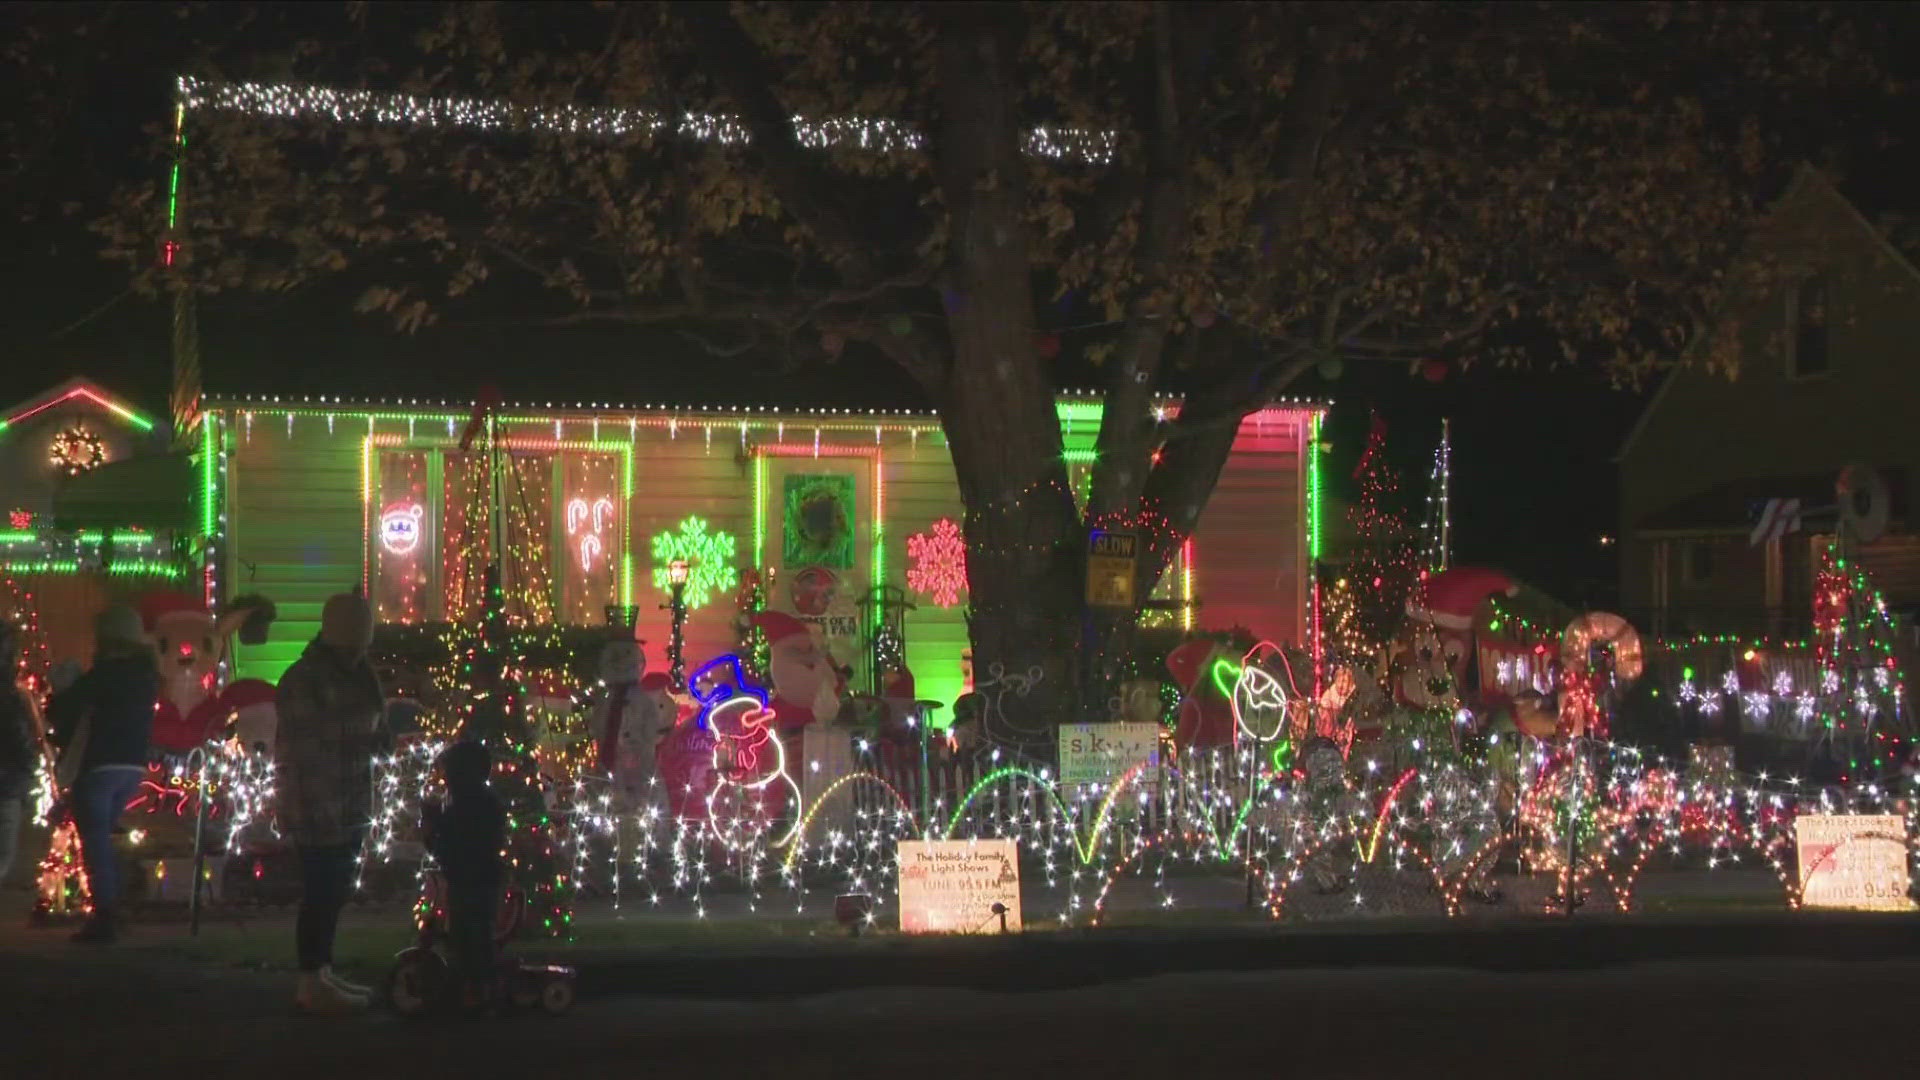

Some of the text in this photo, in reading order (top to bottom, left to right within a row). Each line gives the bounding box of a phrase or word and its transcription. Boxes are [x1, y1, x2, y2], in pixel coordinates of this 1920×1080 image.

[1096, 535, 1133, 555] SLOW
[916, 853, 932, 862] The
[974, 852, 1005, 863] Family
[931, 863, 989, 874] Light Shows
[985, 879, 1001, 890] FM
